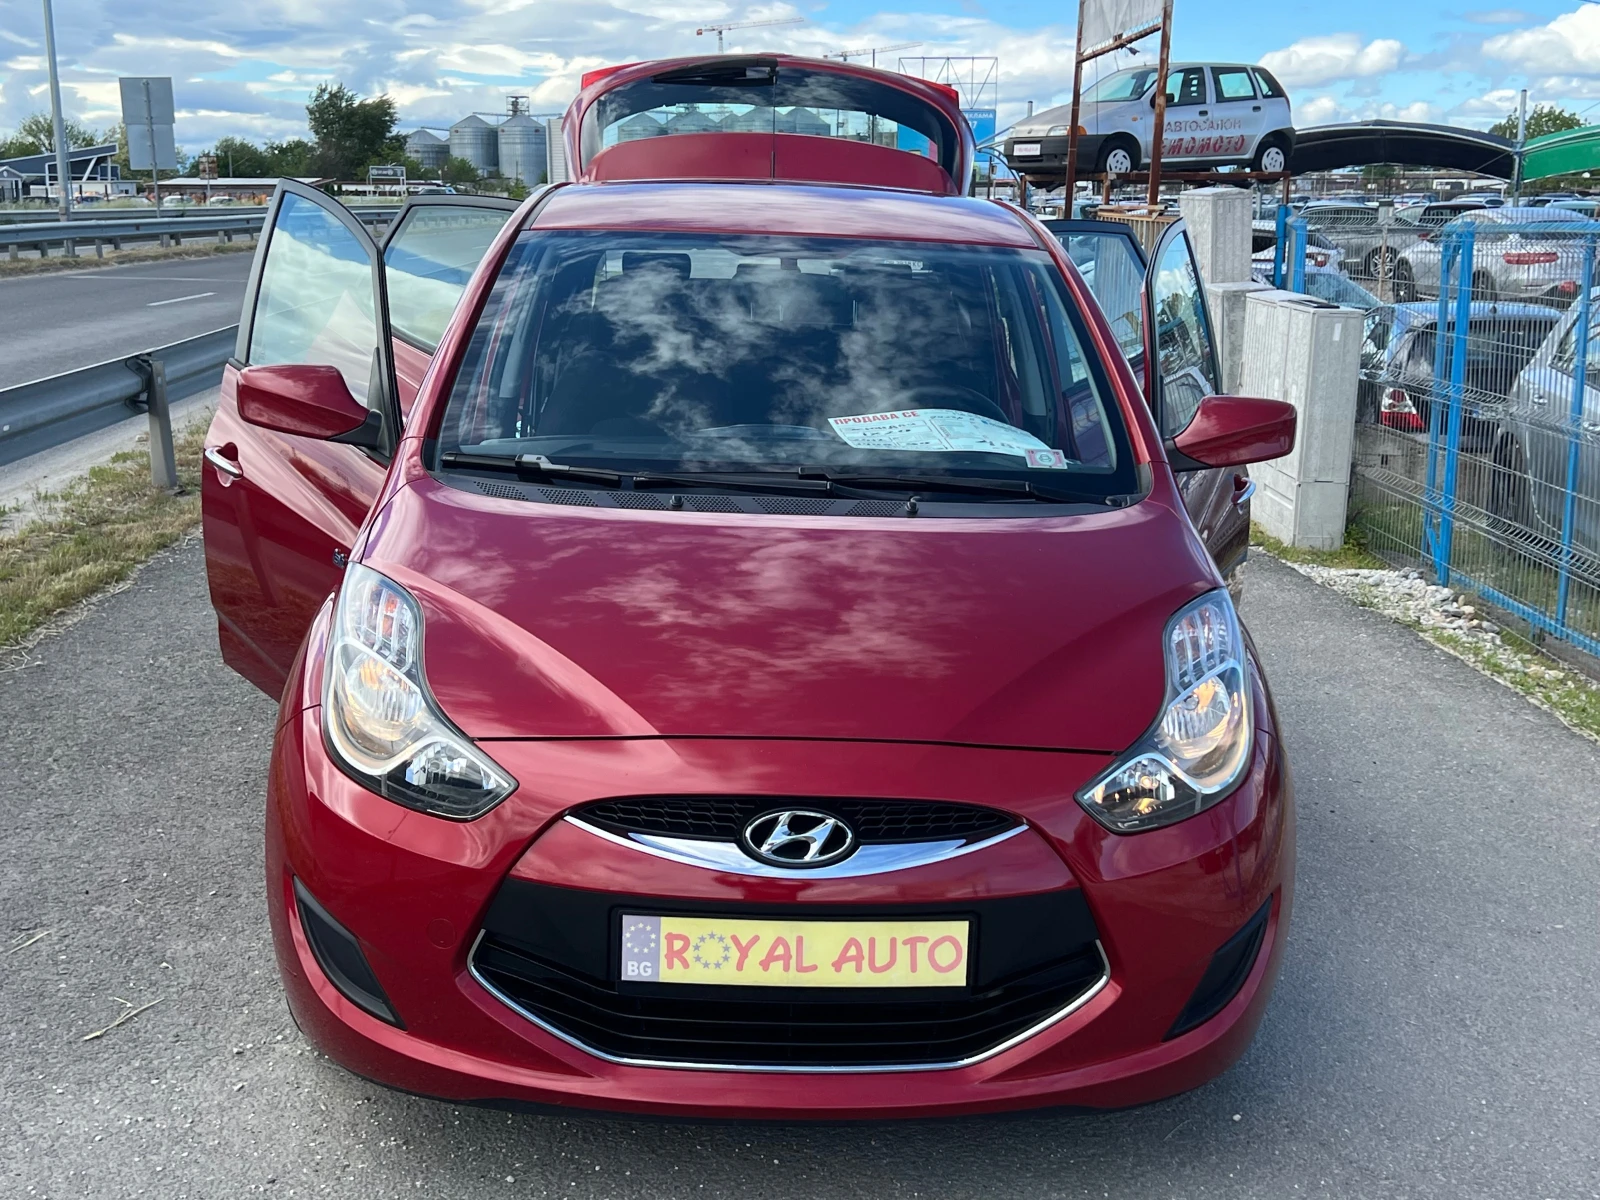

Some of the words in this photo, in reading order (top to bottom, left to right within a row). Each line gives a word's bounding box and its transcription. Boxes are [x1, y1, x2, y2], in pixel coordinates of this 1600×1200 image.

[834, 413, 900, 425] ПРОДАВА
[902, 410, 920, 418] СЕ
[664, 932, 818, 972] ROYAL
[831, 935, 963, 973] AUTO
[627, 961, 652, 976] BG
